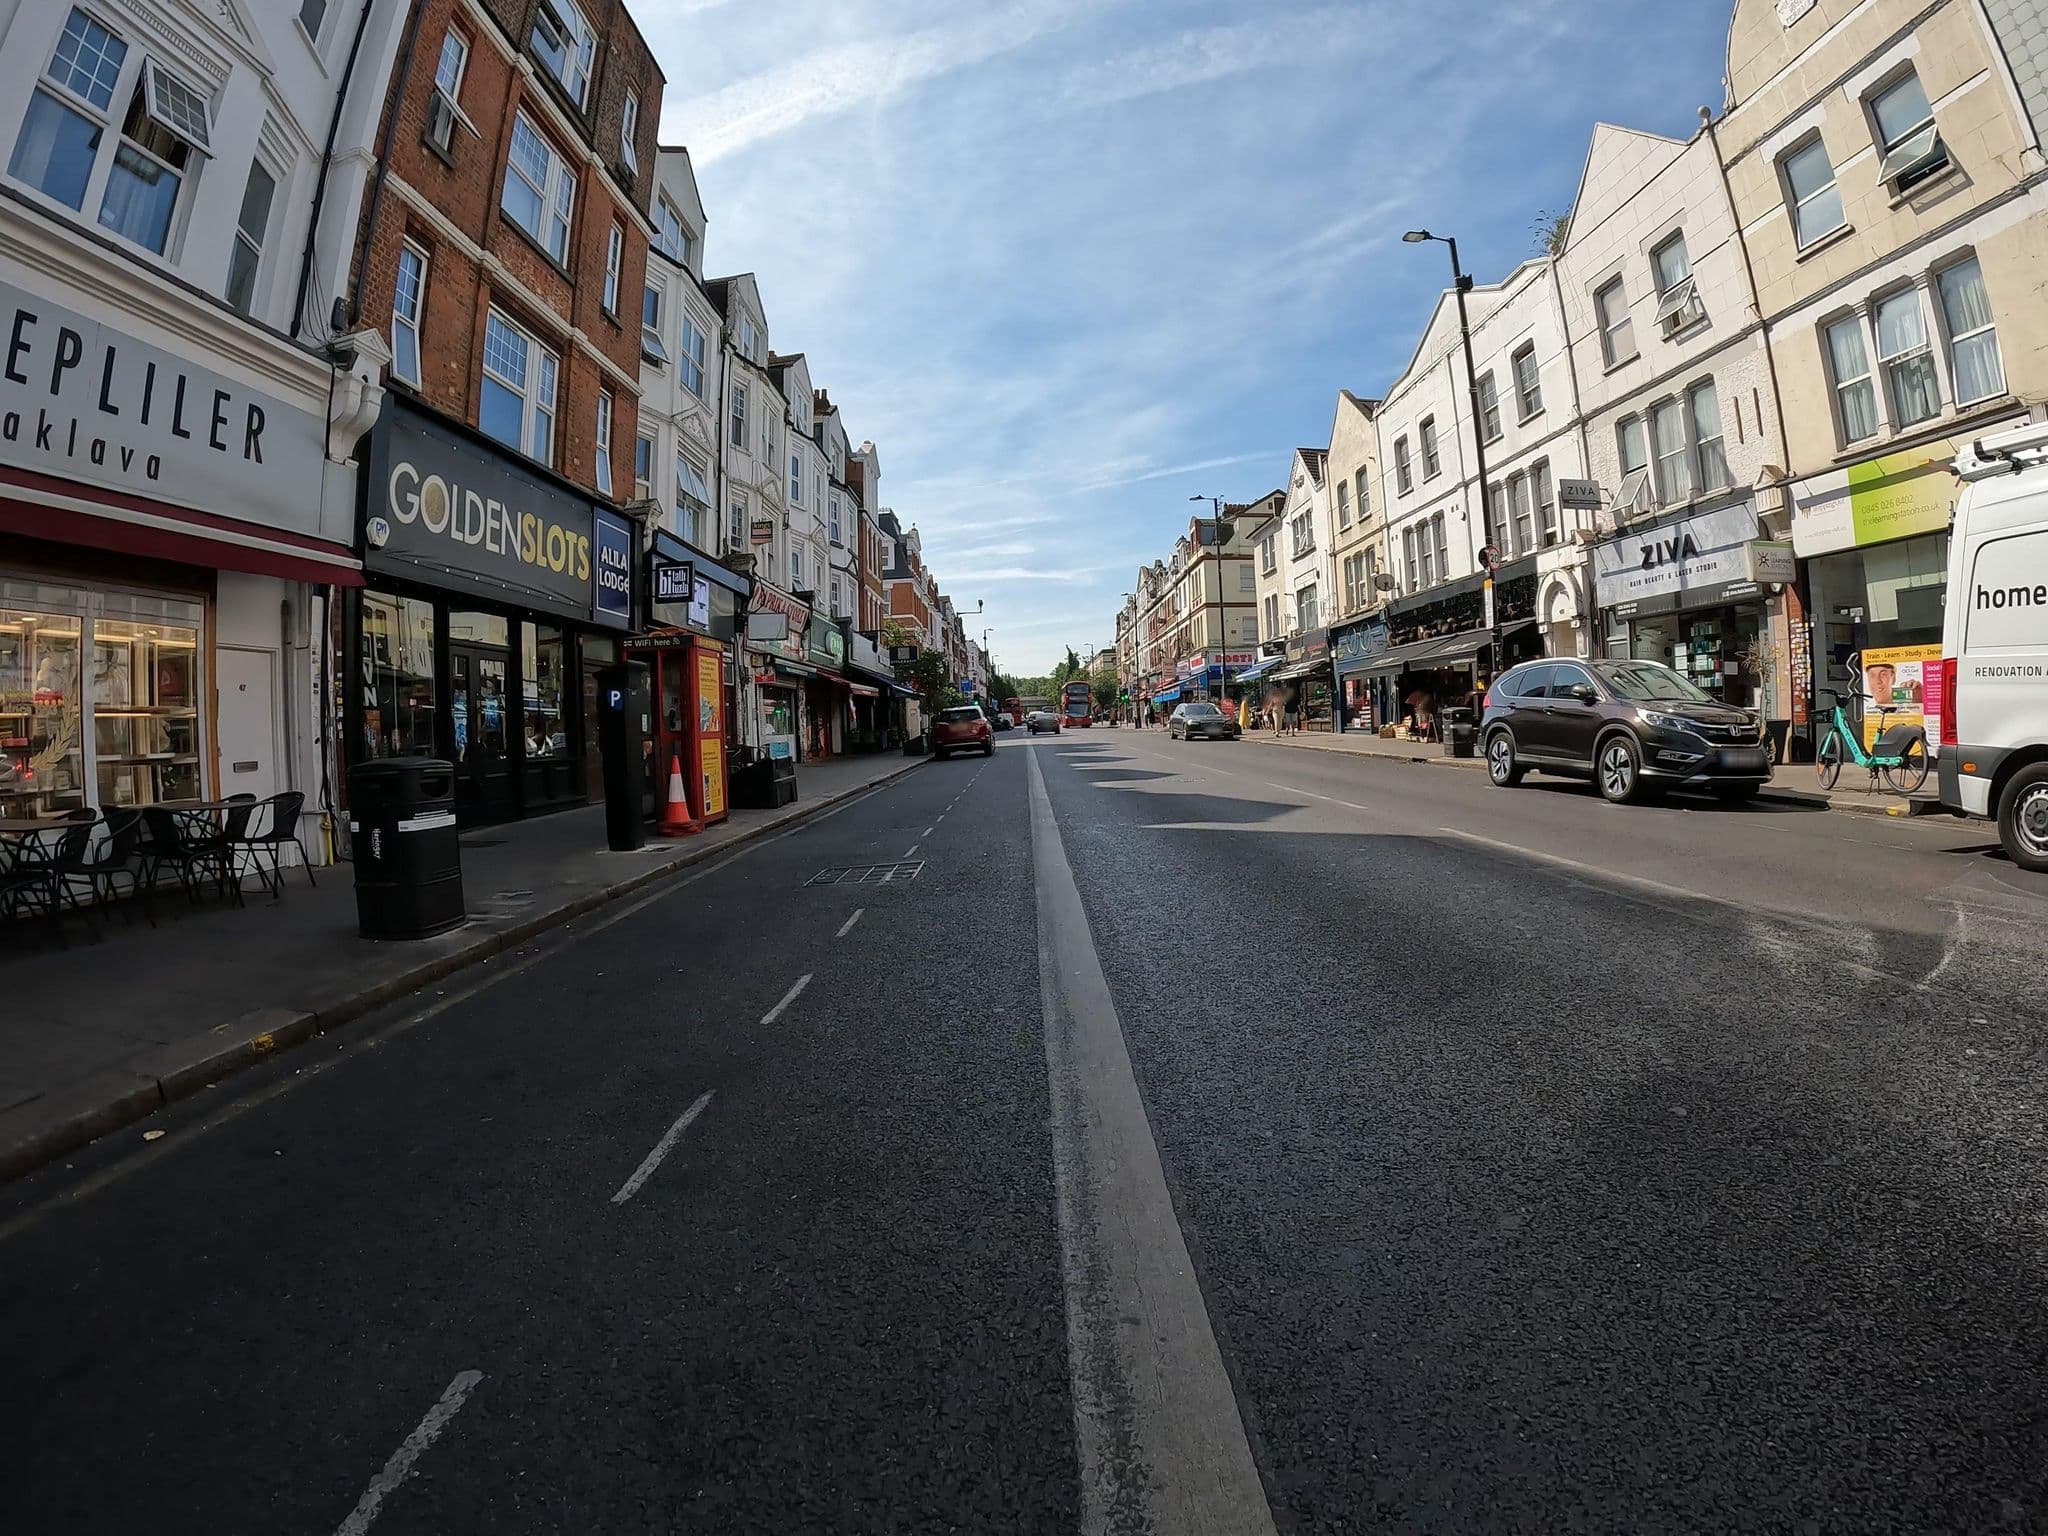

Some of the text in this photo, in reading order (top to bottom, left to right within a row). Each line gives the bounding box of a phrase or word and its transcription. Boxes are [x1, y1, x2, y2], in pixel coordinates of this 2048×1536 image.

[5, 308, 266, 465] EPLILER
[3, 408, 161, 480] aklava
[1567, 485, 1596, 497] ZIVA
[601, 545, 628, 572] ALILA
[1490, 553, 1499, 564] 20
[1639, 533, 1700, 571] ZIVA
[598, 567, 630, 594] LODGE
[659, 570, 672, 594] bi
[1644, 574, 1664, 585] BEAUTY
[1977, 584, 2047, 610] home
[634, 639, 651, 647] WiFi
[654, 638, 671, 647] here
[1905, 649, 1922, 658] Study
[1975, 665, 2042, 678] RENOVATION
[610, 690, 621, 707] P
